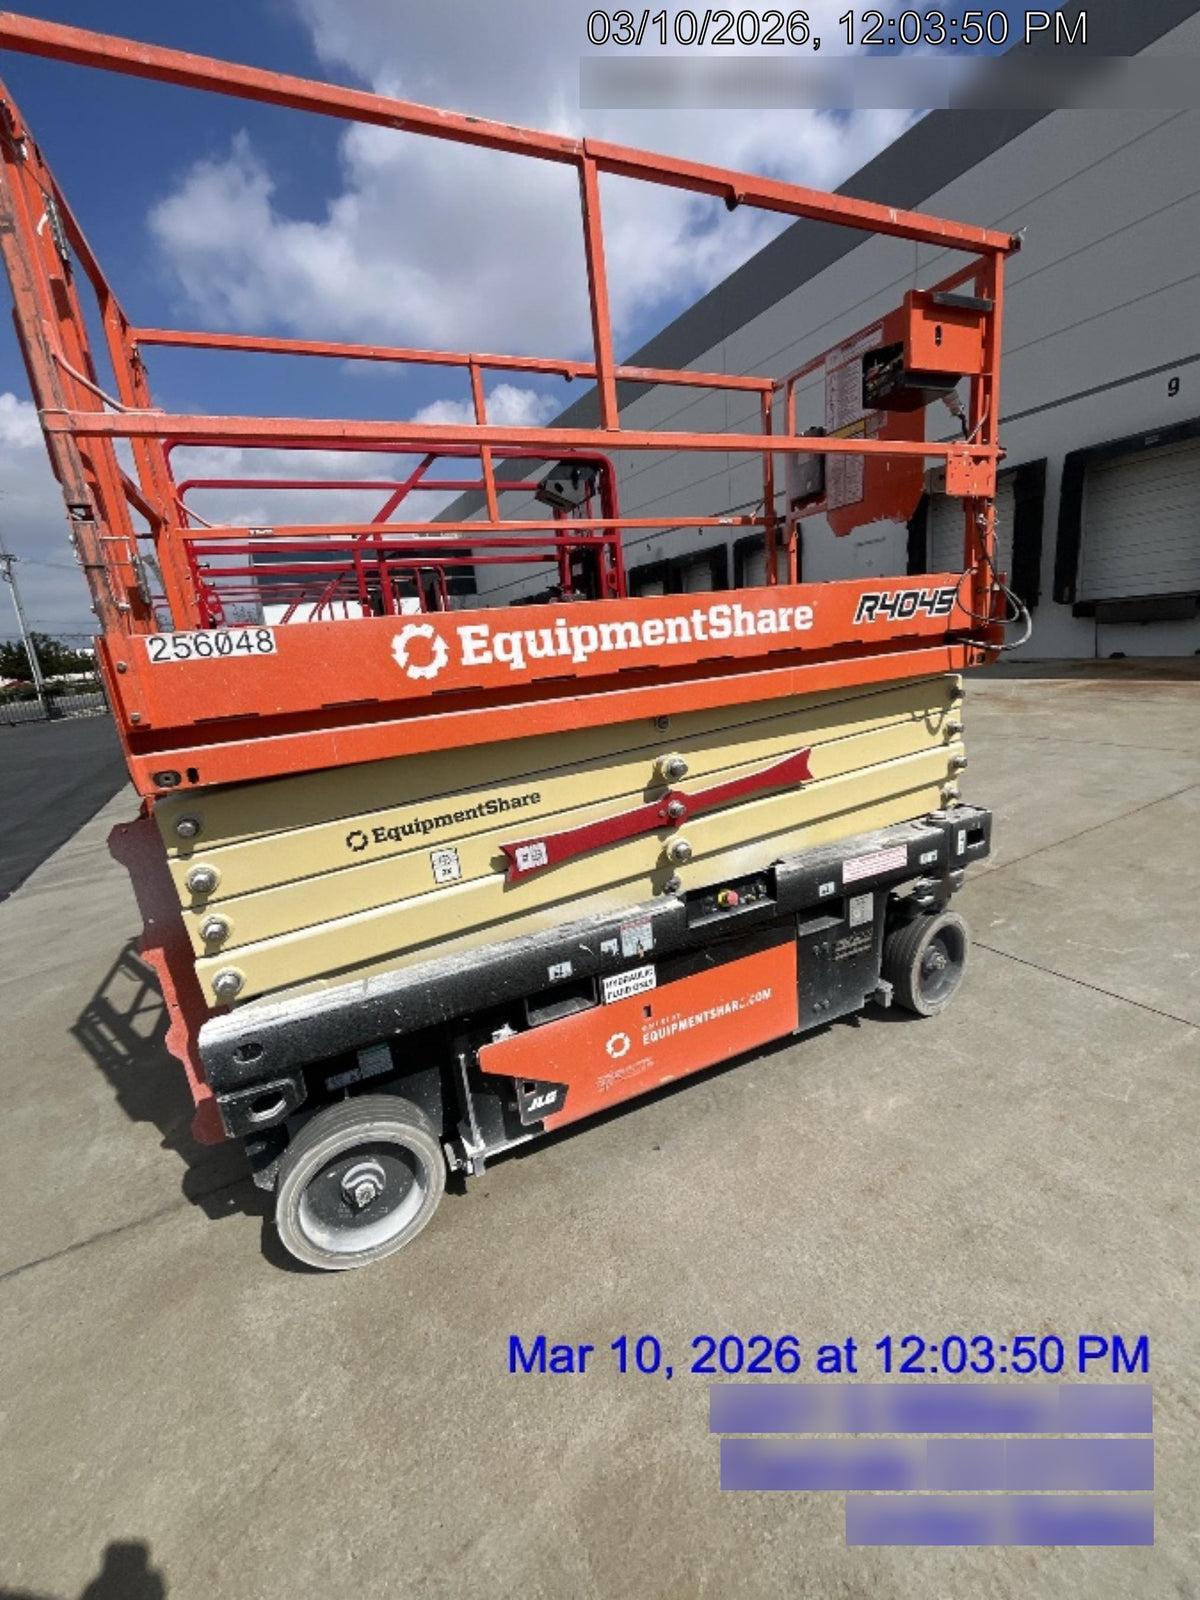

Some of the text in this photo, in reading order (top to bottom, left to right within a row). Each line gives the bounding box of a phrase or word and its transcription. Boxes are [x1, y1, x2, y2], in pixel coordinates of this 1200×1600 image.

[1168, 377, 1180, 397] 9
[853, 586, 957, 625] R4045
[148, 629, 274, 662] 256048
[456, 602, 815, 670] EquipmentShare
[371, 792, 541, 843] EquipmentShare
[527, 1089, 558, 1112] JLG
